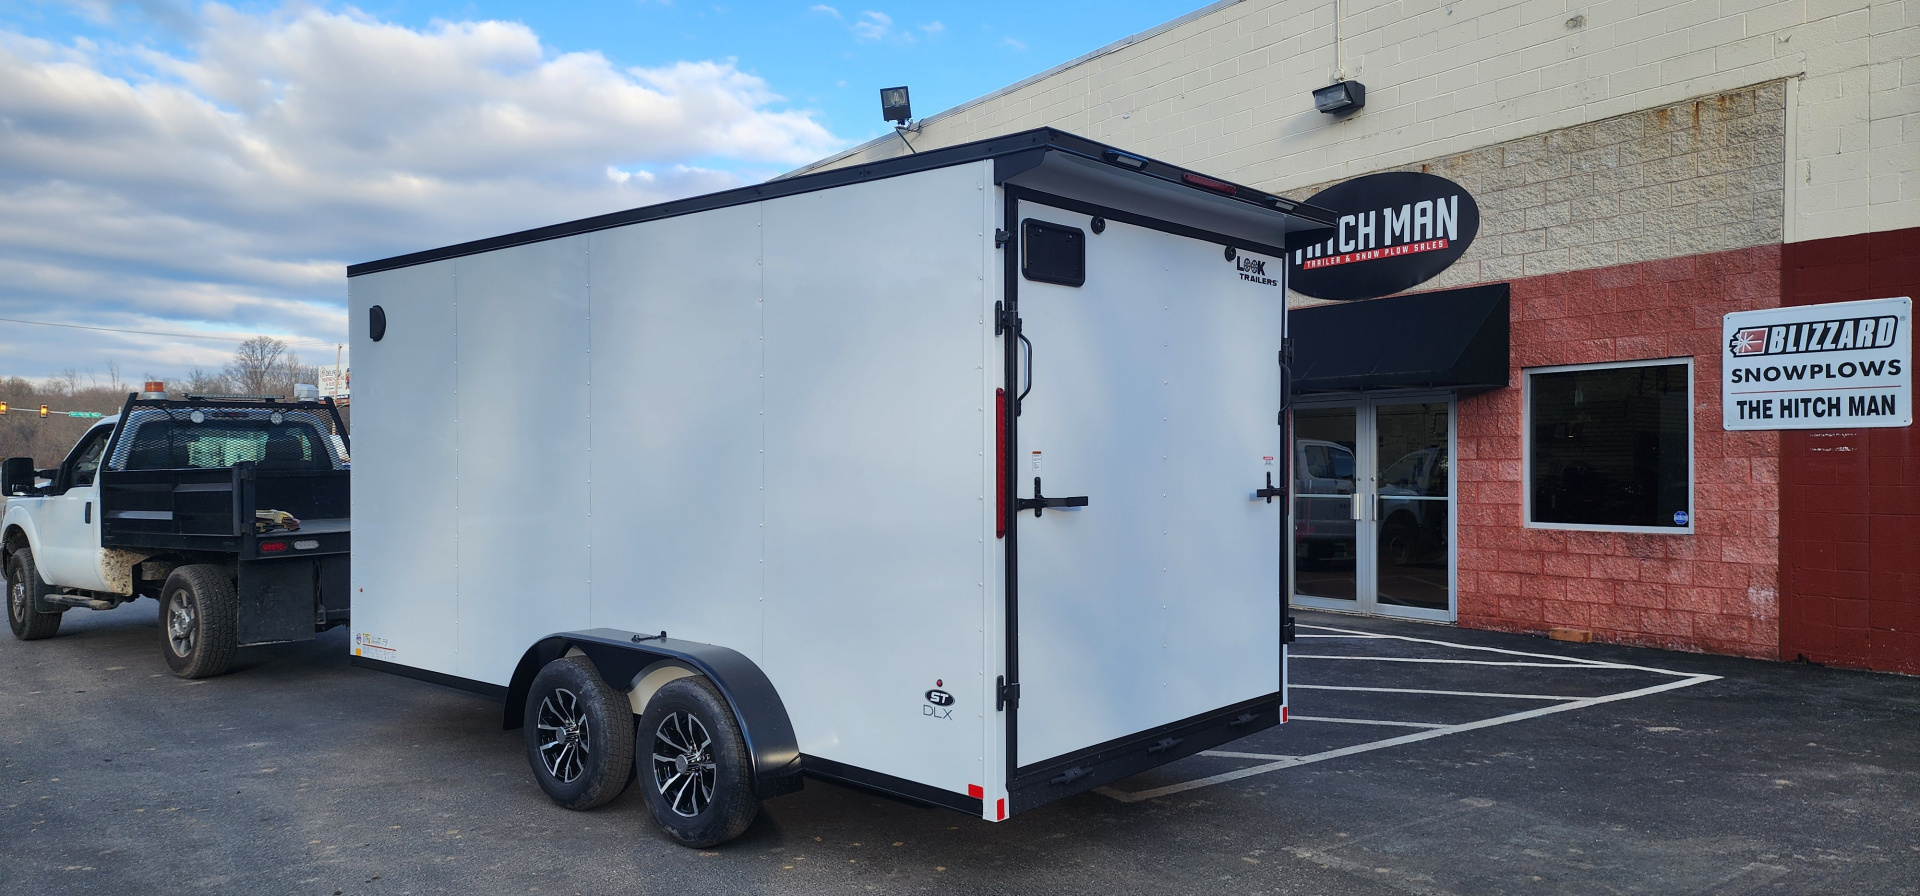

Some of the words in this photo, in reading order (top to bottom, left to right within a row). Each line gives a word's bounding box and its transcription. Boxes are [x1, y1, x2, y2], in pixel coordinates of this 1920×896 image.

[1383, 194, 1458, 246] MAN
[1236, 255, 1266, 276] LOOK
[1306, 256, 1341, 268] TRAILER
[1345, 253, 1351, 262] &
[1355, 249, 1380, 260] SNOW
[1384, 245, 1409, 256] PLOW
[1413, 240, 1444, 252] SALES
[1239, 272, 1279, 287] TRAILERS
[1768, 317, 1897, 354] BLIZZARD
[1731, 359, 1902, 384] SNOWPLOWS
[1737, 399, 1774, 420] THE
[1780, 396, 1841, 419] HITCH
[1848, 394, 1897, 417] MAN
[930, 691, 949, 704] ST
[923, 704, 953, 721] DLX
